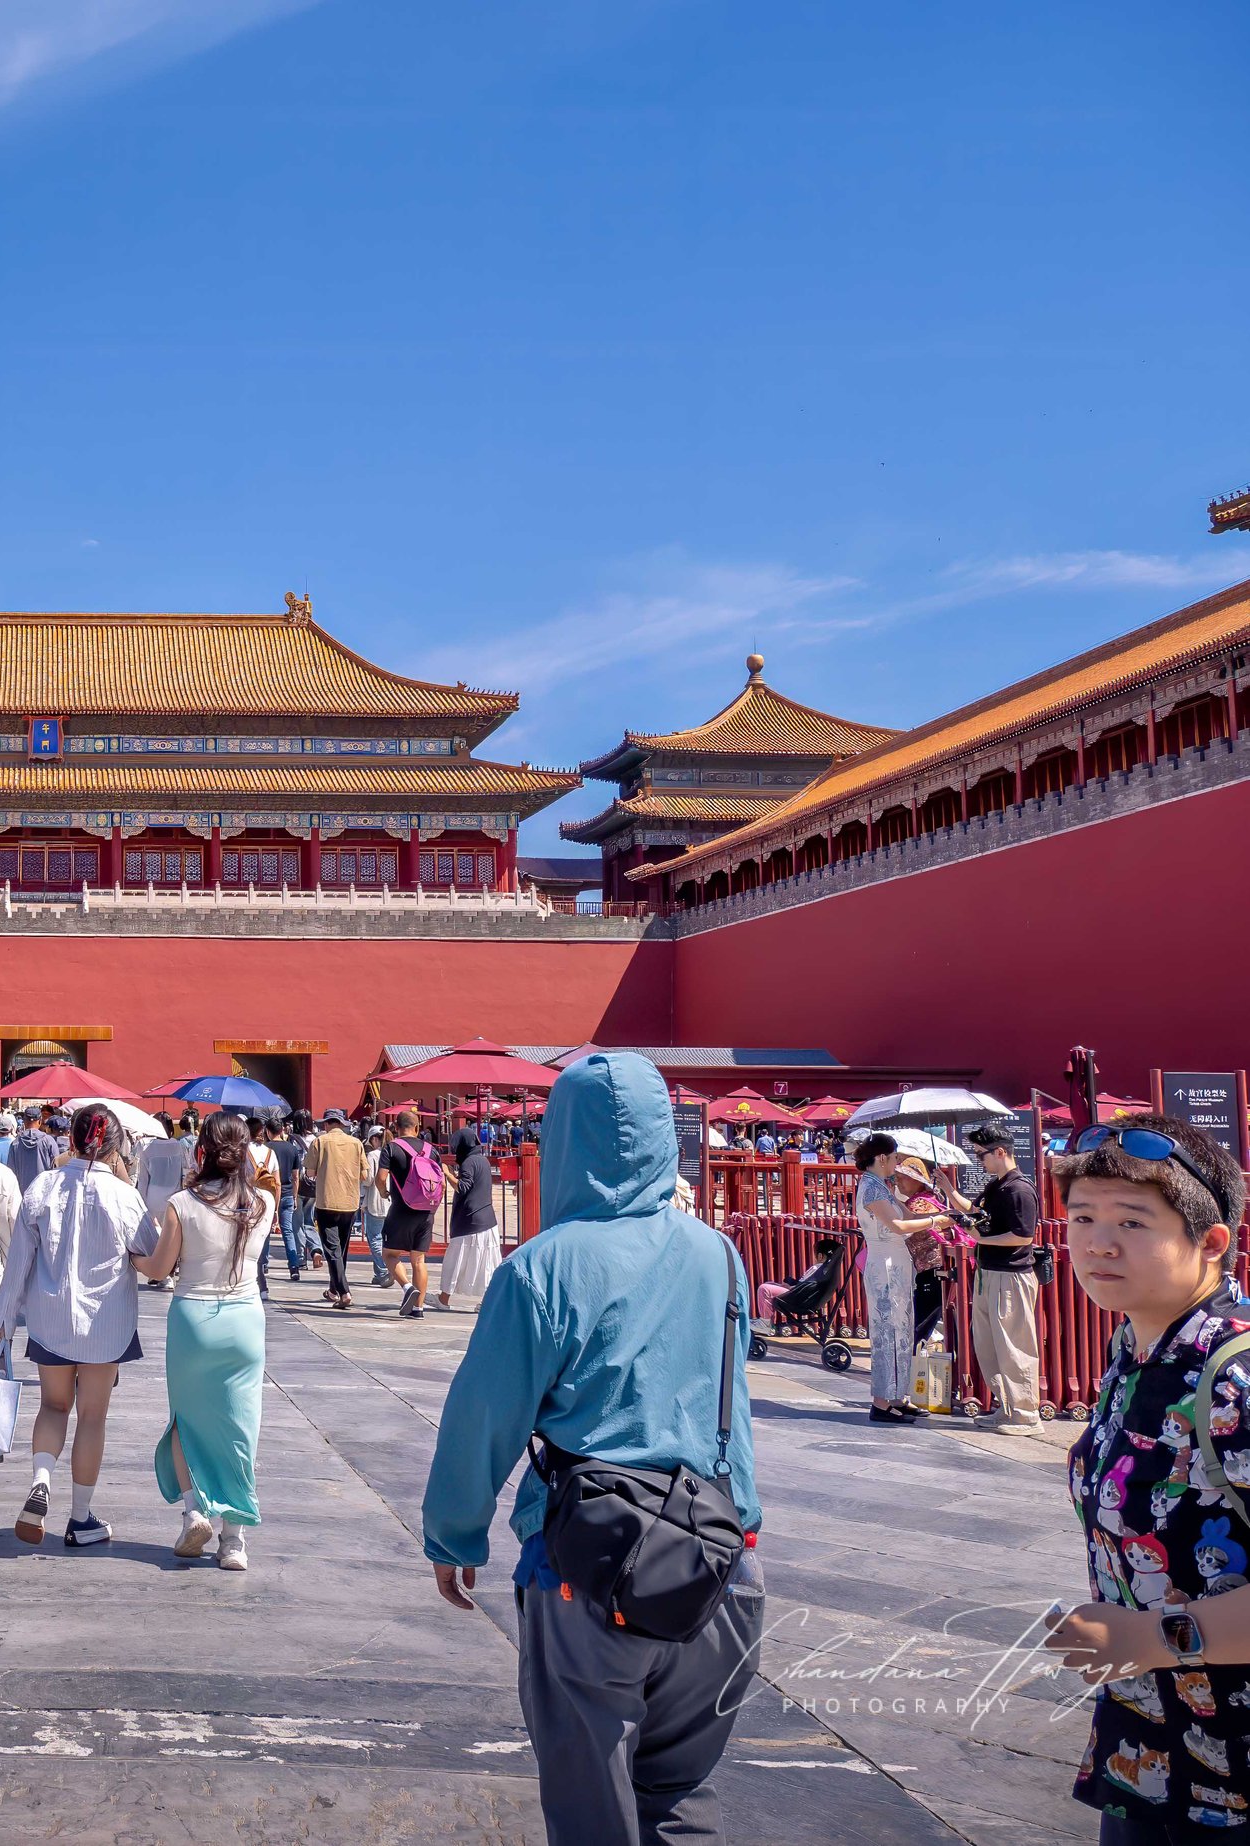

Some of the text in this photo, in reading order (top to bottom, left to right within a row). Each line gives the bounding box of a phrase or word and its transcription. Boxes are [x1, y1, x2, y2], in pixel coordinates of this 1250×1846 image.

[777, 1084, 785, 1093] 7
[1188, 1089, 1227, 1098] 故宫检票处
[1190, 1115, 1228, 1123] 无障碍入口
